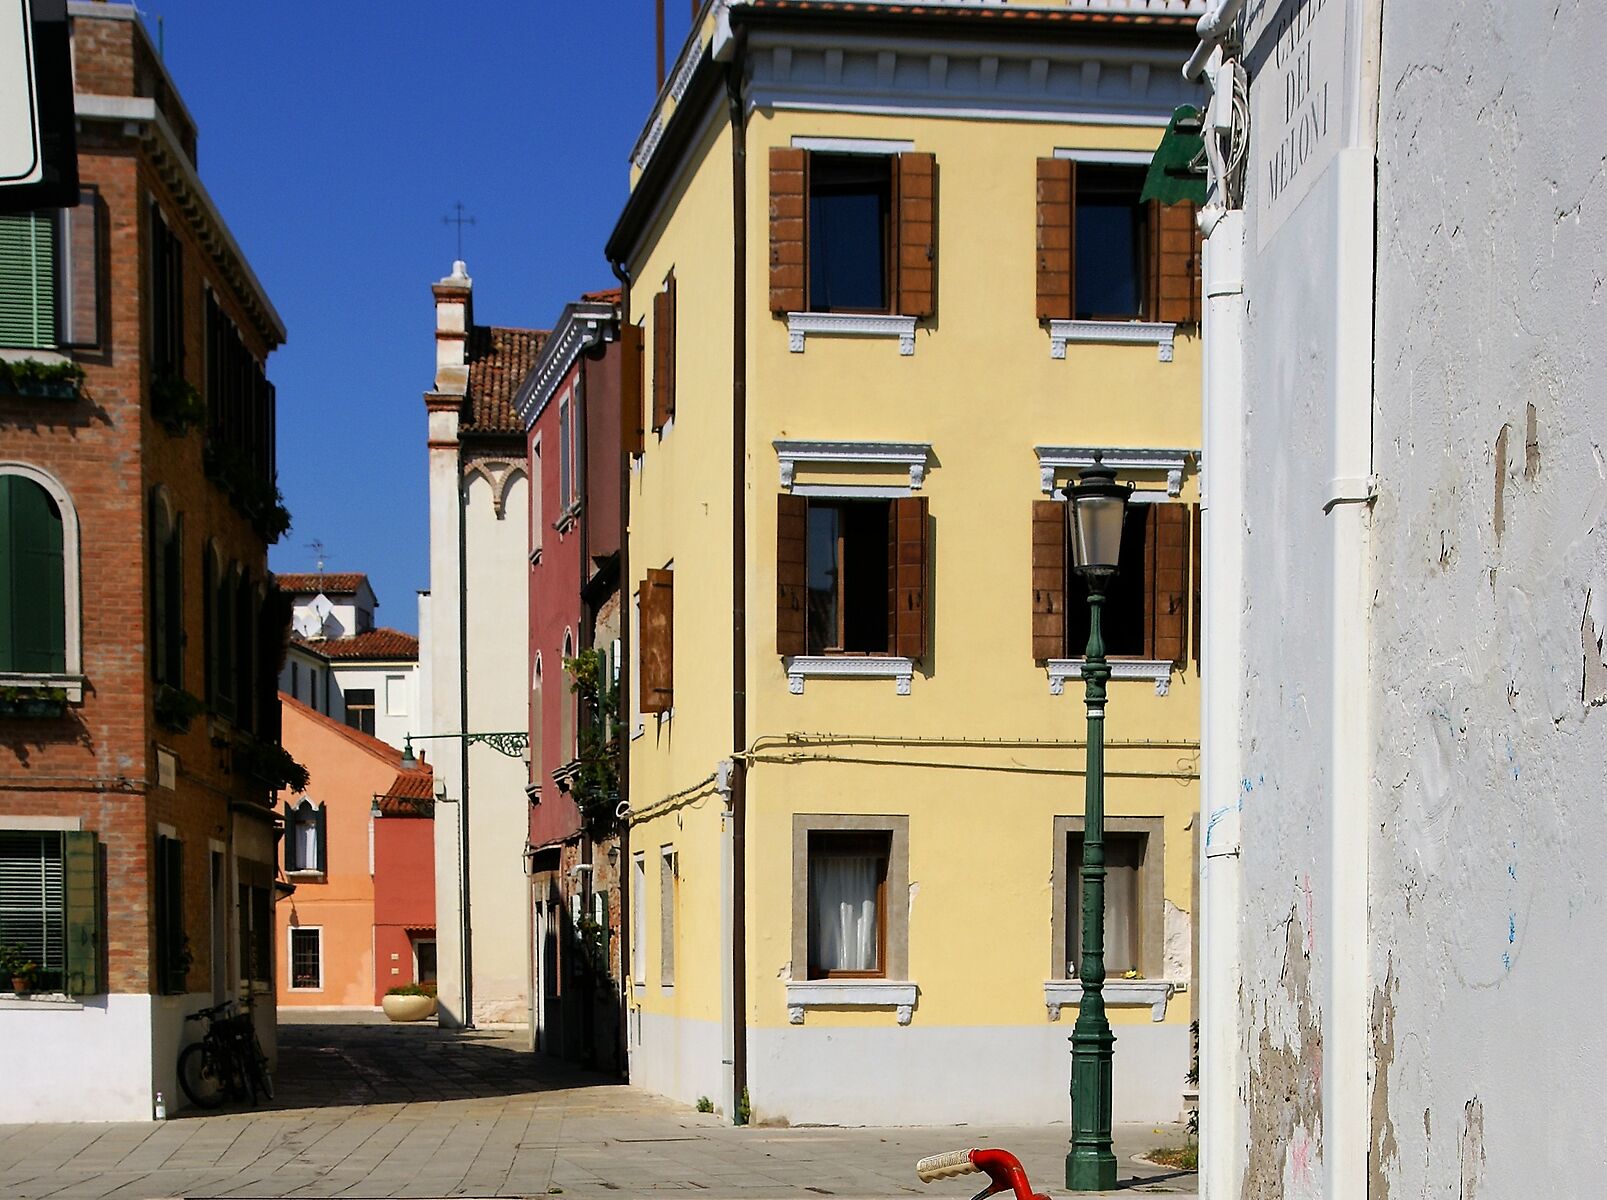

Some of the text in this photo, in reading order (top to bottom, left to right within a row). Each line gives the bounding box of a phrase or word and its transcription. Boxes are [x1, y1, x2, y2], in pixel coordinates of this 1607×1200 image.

[1276, 0, 1326, 69] CALL
[1286, 40, 1312, 124] DEI
[1268, 81, 1328, 209] MELONI
